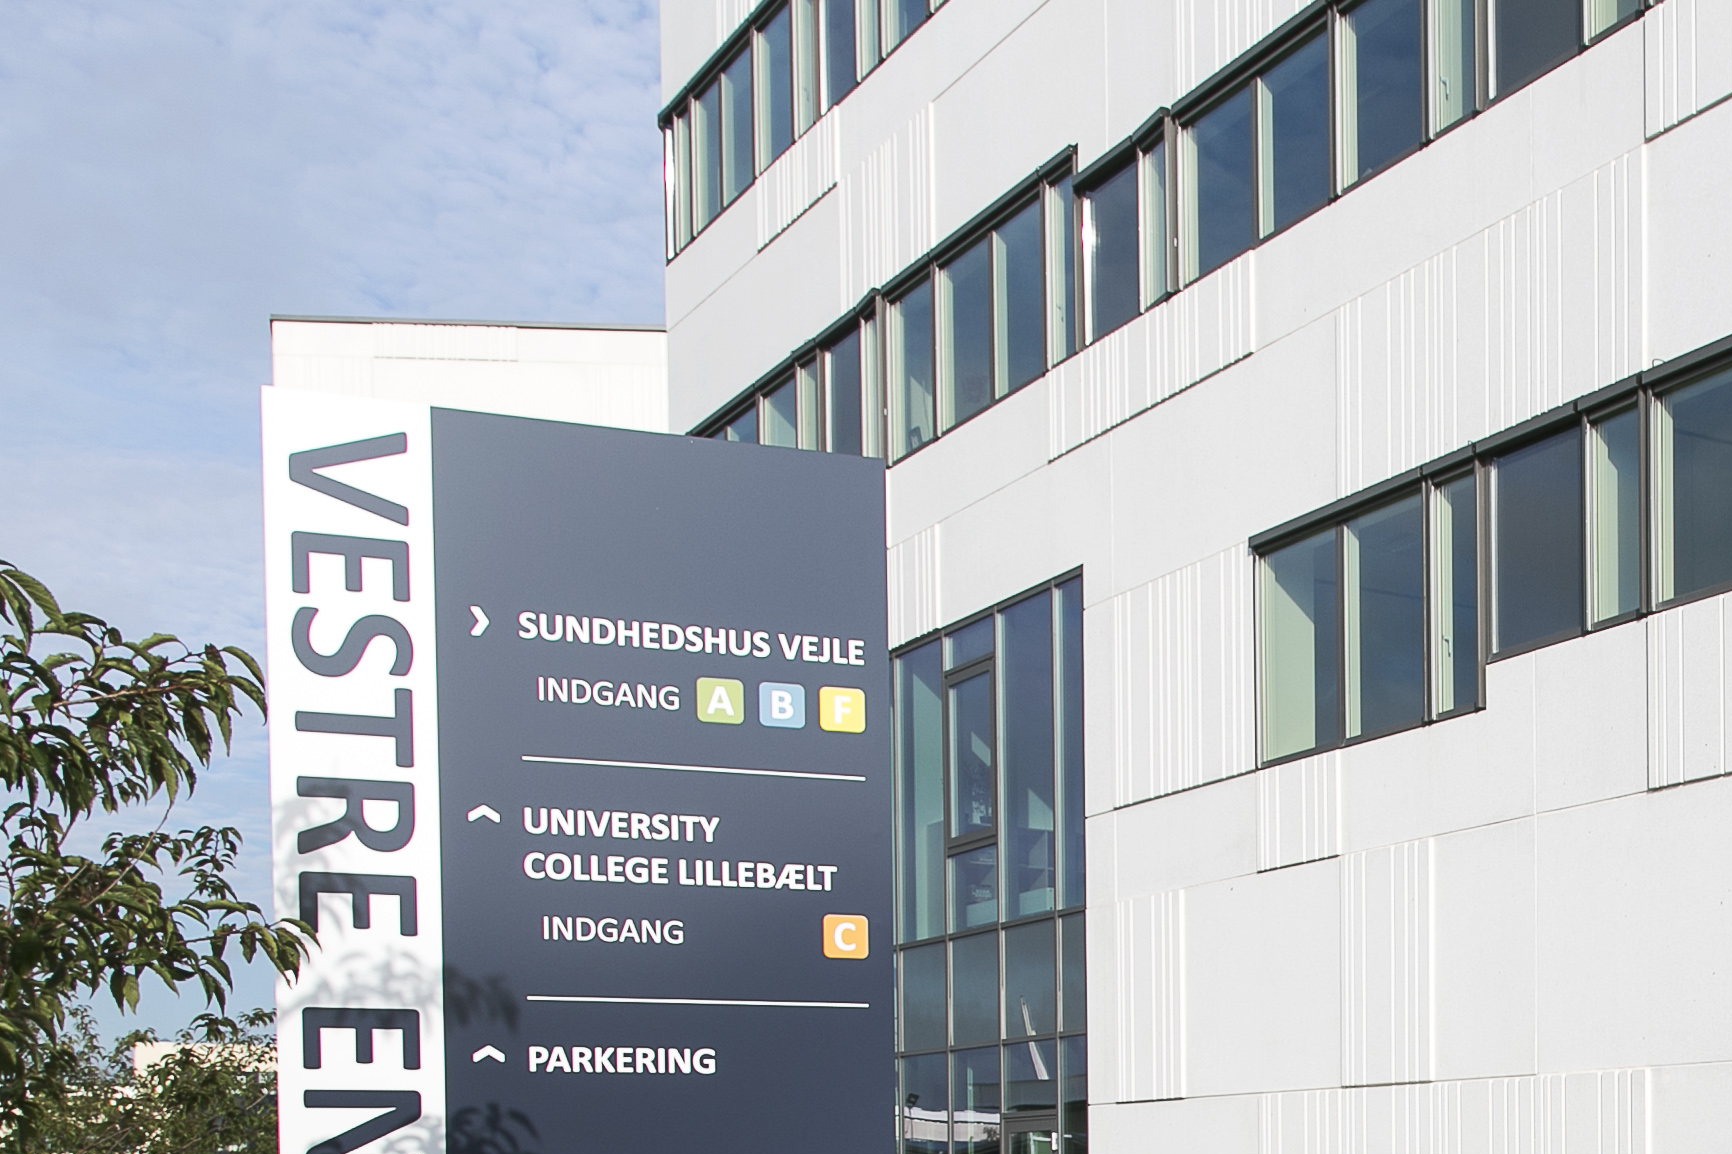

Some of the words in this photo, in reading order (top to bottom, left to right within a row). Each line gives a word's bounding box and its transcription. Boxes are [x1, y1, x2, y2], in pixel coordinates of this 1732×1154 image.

[518, 611, 771, 658] SUNDHEDSHUS
[777, 633, 865, 666] VEJLE
[288, 432, 418, 937] VESTRE
[537, 676, 680, 711] INDGANG
[523, 807, 720, 843] UNIVERSITY
[523, 852, 669, 884] COLLEGE
[677, 858, 839, 892] LILLEBÆLT
[543, 915, 684, 945] INDGANG
[528, 1046, 716, 1075] PARKERING
